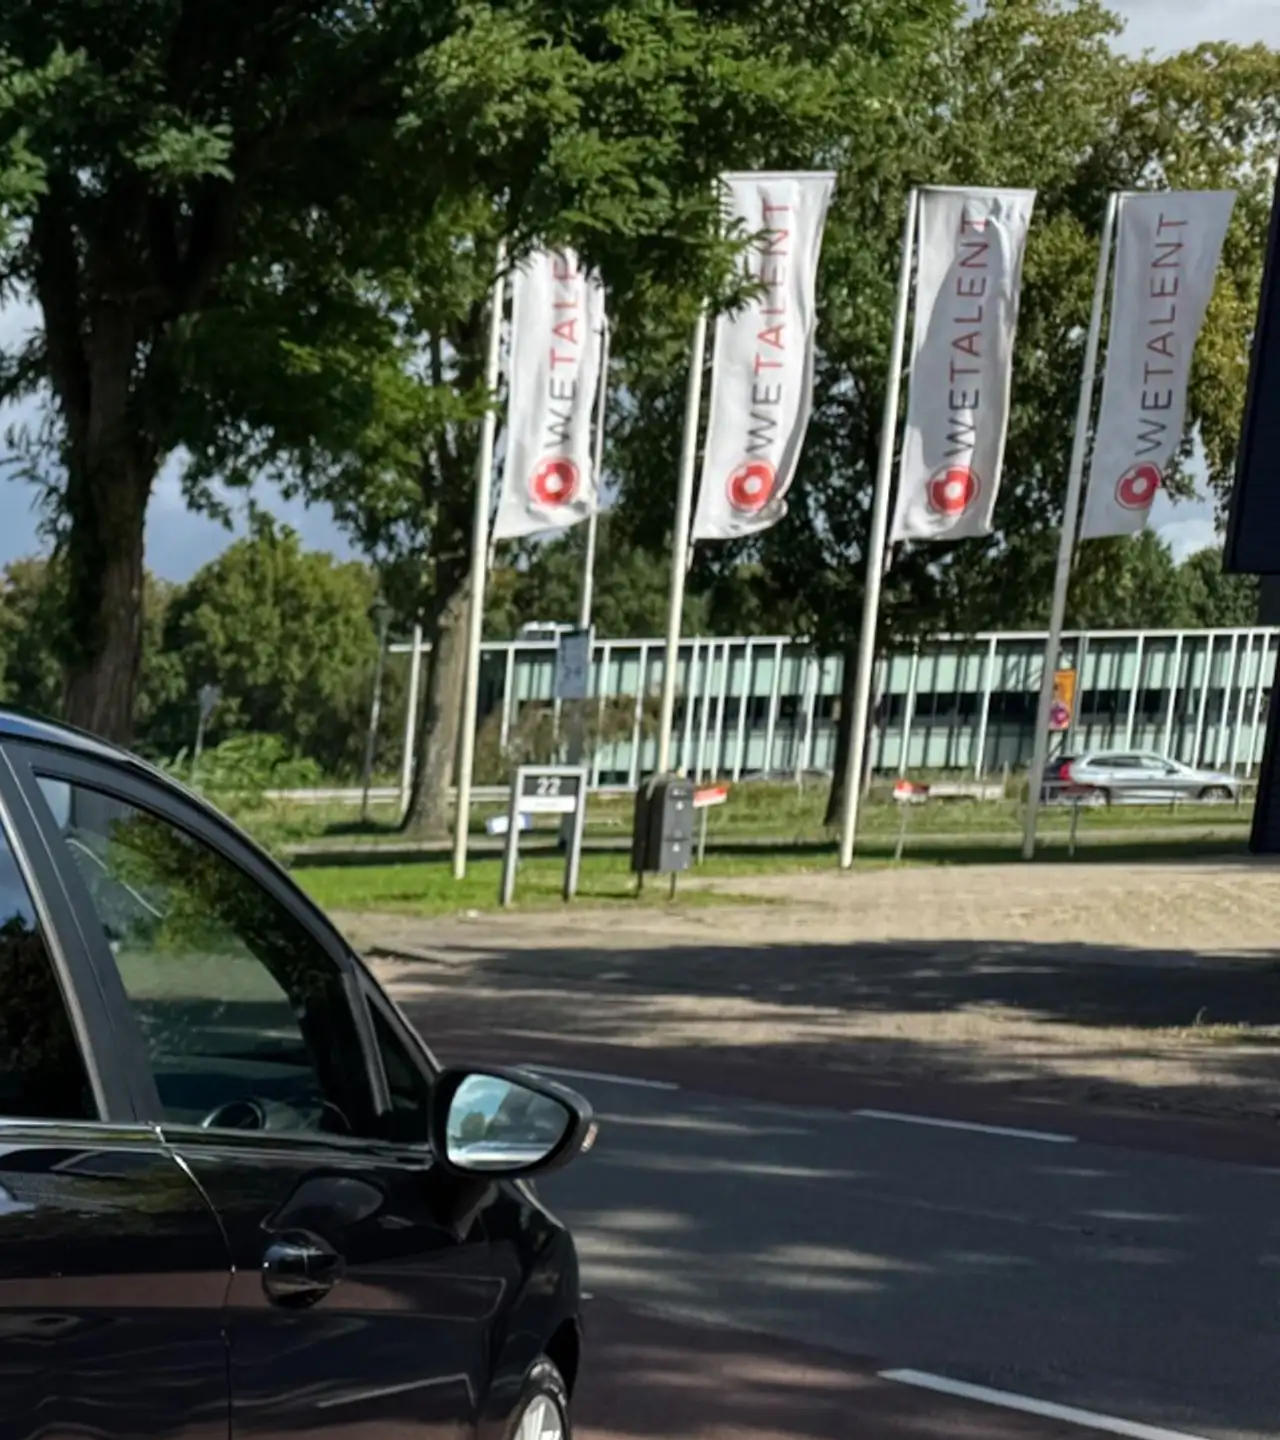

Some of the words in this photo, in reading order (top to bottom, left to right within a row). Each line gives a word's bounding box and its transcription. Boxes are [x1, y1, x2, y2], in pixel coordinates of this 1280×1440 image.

[745, 198, 791, 455] WETALENT
[943, 203, 992, 458] WETALENT
[1134, 212, 1189, 457] WETALENT
[536, 776, 561, 796] 22
